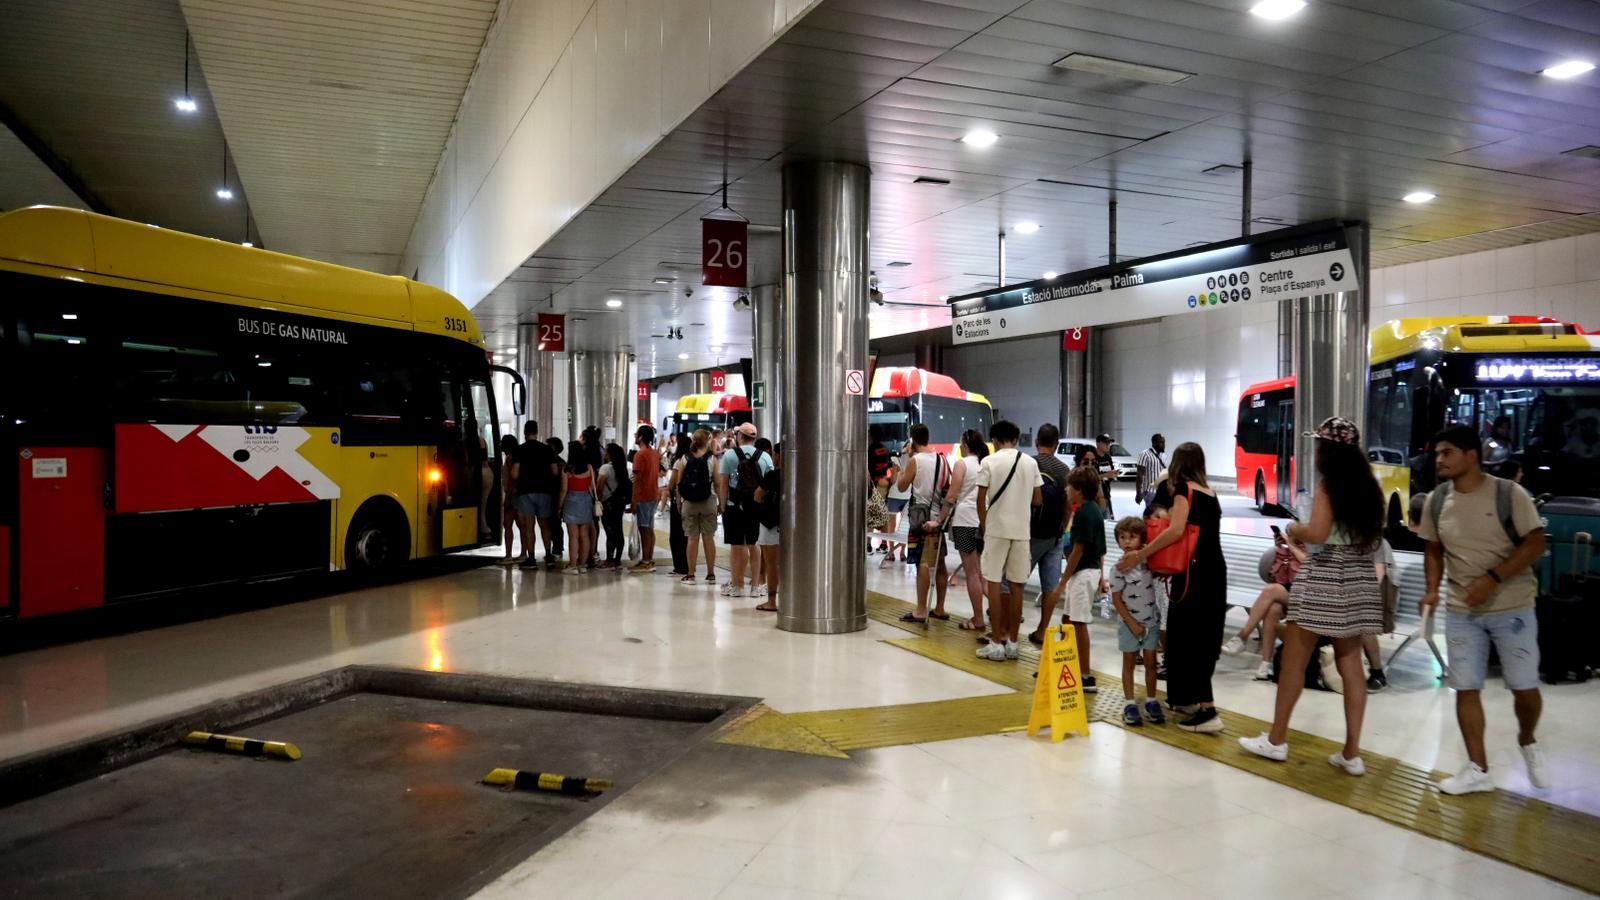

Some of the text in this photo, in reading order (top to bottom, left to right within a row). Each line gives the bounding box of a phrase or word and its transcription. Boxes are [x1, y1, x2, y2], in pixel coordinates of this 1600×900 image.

[707, 239, 743, 269] 26
[1270, 249, 1295, 260] Sortida
[1259, 269, 1294, 283] Centre
[1022, 287, 1051, 304] Estació
[1113, 273, 1144, 289] Palma
[1260, 283, 1281, 294] Plaça
[444, 317, 467, 333] 3151
[963, 317, 991, 329] Parc de les
[238, 318, 348, 345] BUS DE GAS NATURAL
[541, 325, 562, 342] 25
[964, 328, 990, 339] Estacions
[1072, 326, 1082, 341] 8
[712, 376, 724, 387] 10
[638, 387, 647, 396] 11
